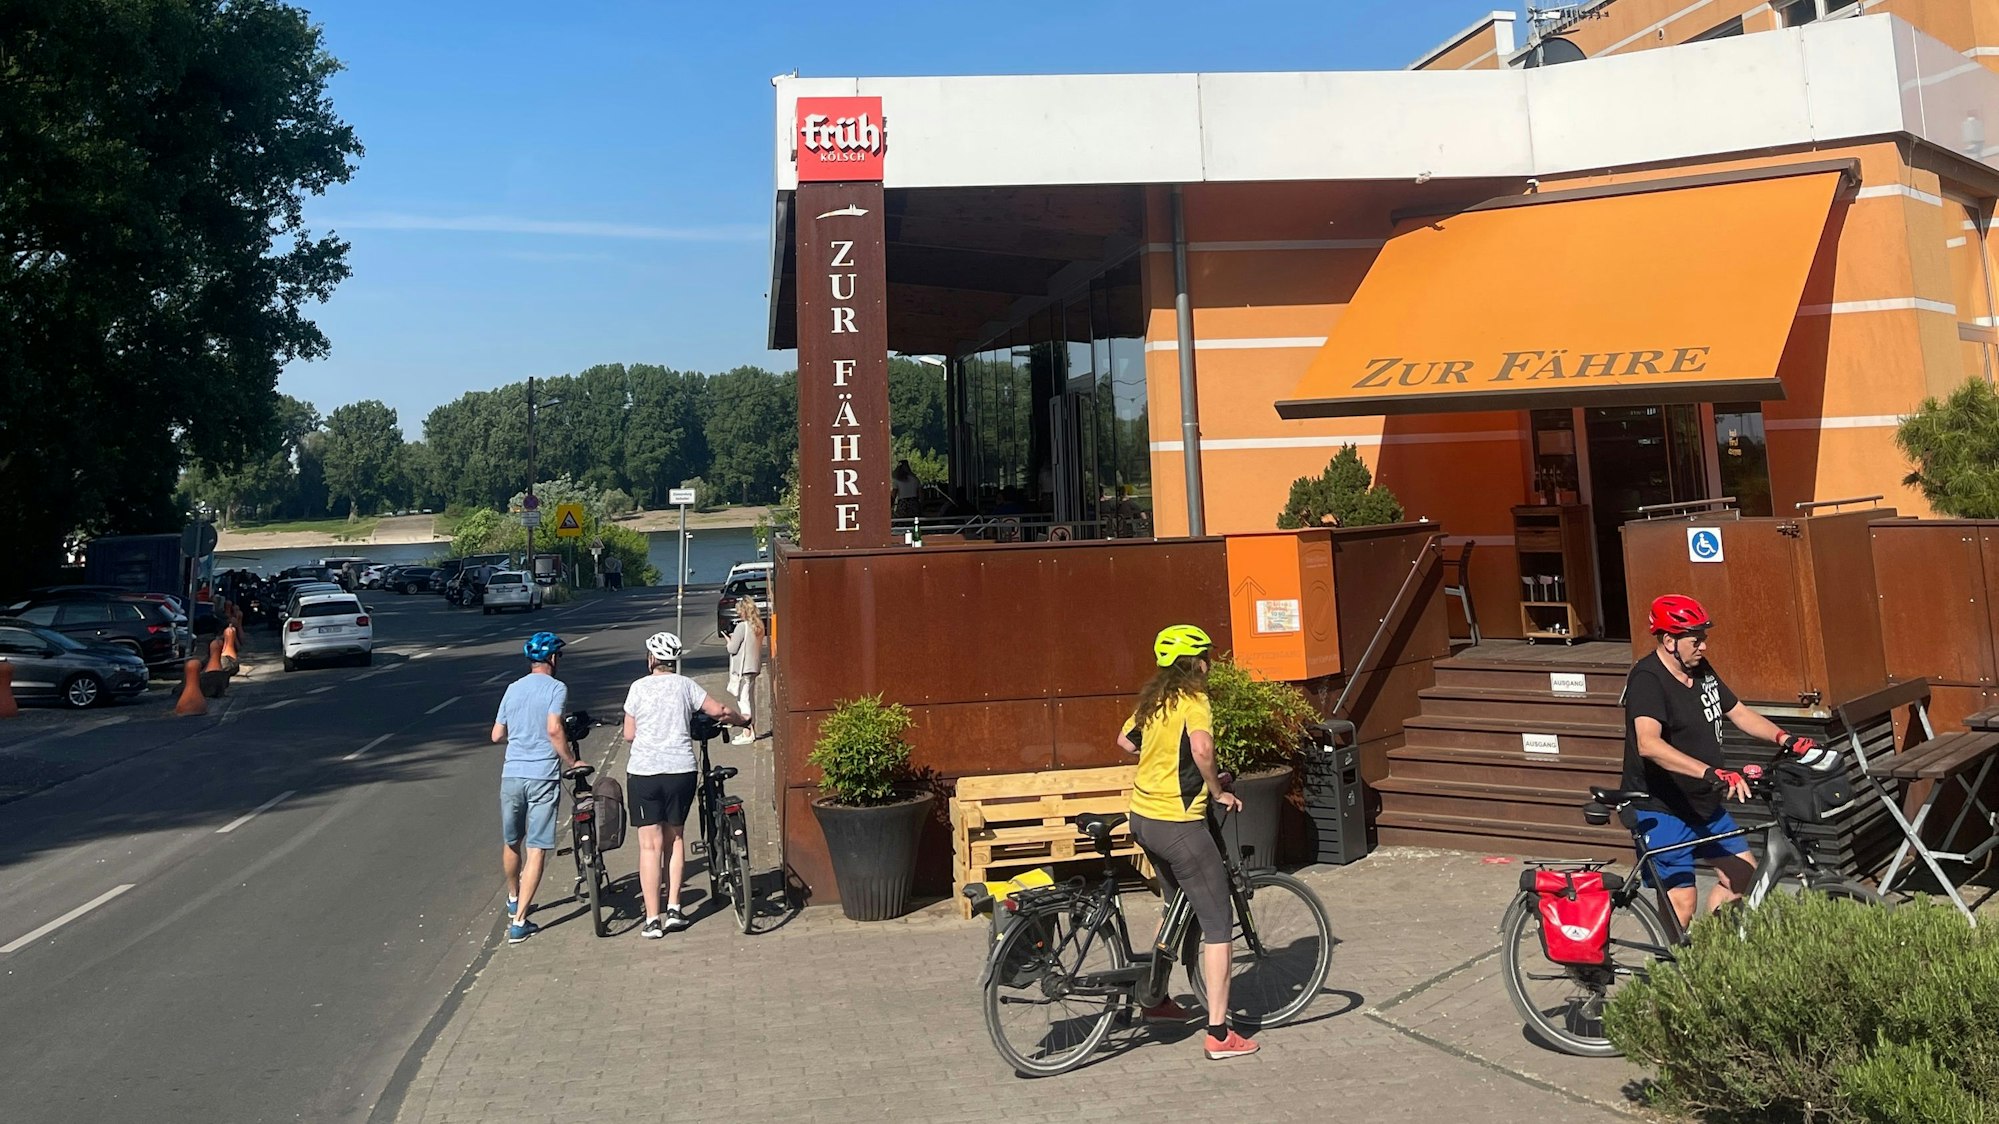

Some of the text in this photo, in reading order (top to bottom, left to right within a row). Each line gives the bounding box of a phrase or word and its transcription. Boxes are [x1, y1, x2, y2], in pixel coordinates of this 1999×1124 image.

[820, 152, 865, 162] KÖLSCH
[1351, 346, 1711, 389] ZUR FÄHRE
[829, 240, 862, 532] ZUR FÄHRE
[1525, 740, 1557, 748] AUSGANG
